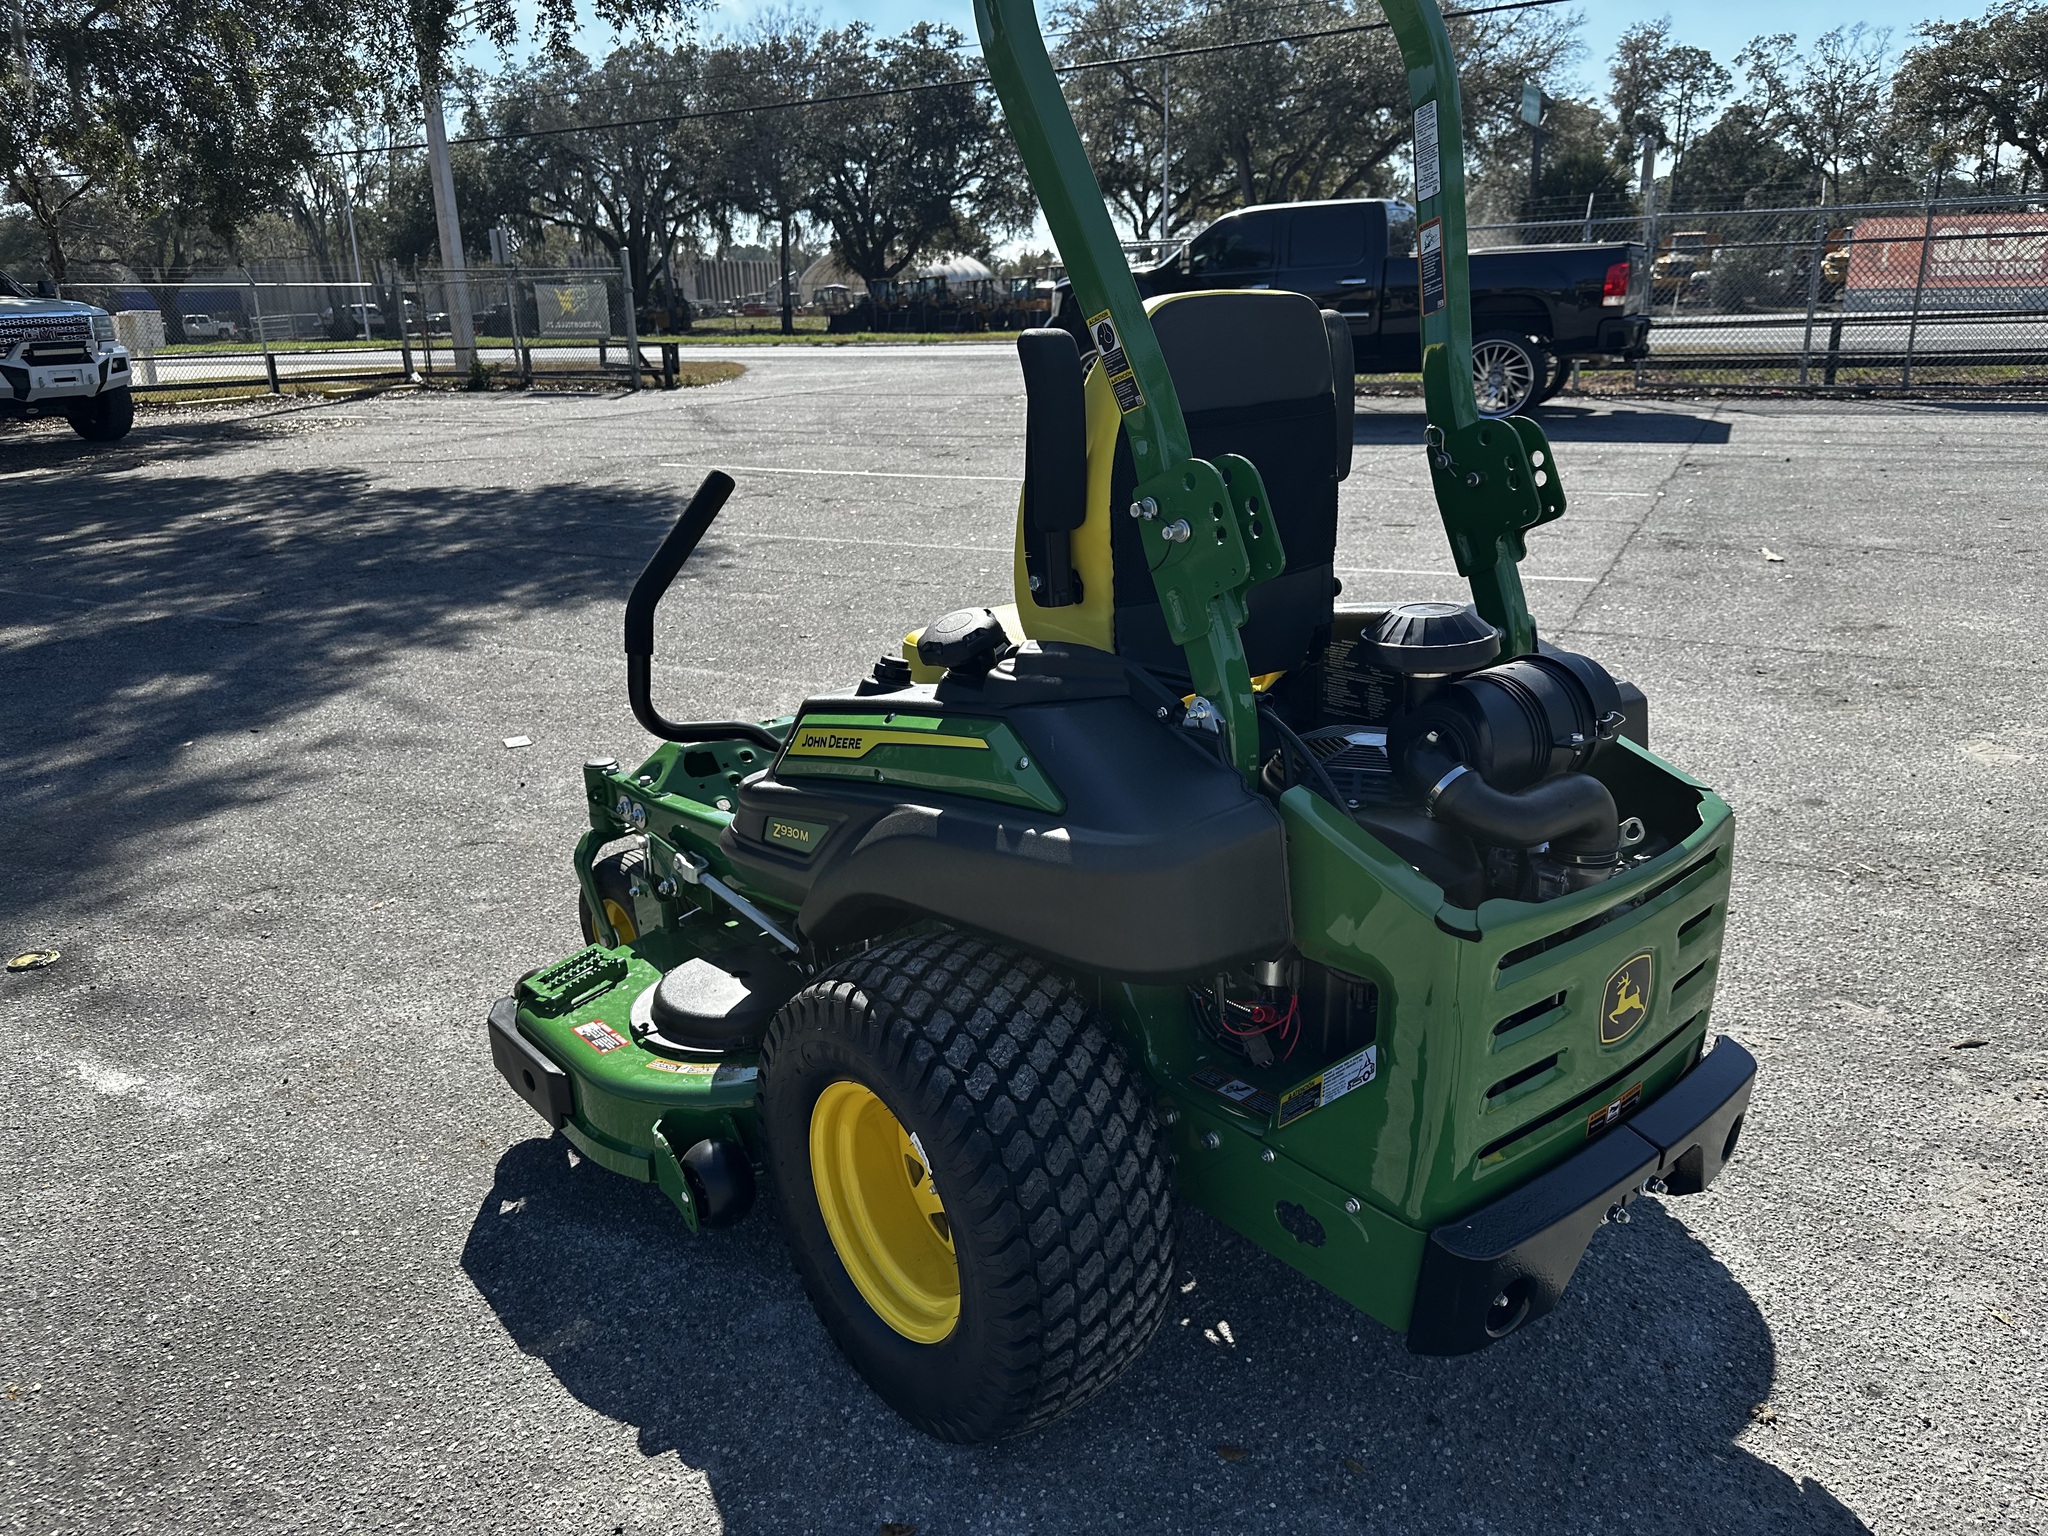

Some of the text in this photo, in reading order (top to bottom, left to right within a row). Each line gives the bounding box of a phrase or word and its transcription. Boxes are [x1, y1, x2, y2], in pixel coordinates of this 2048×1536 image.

[802, 734, 863, 750] JOHN DEERE
[772, 822, 810, 842] Z930M
